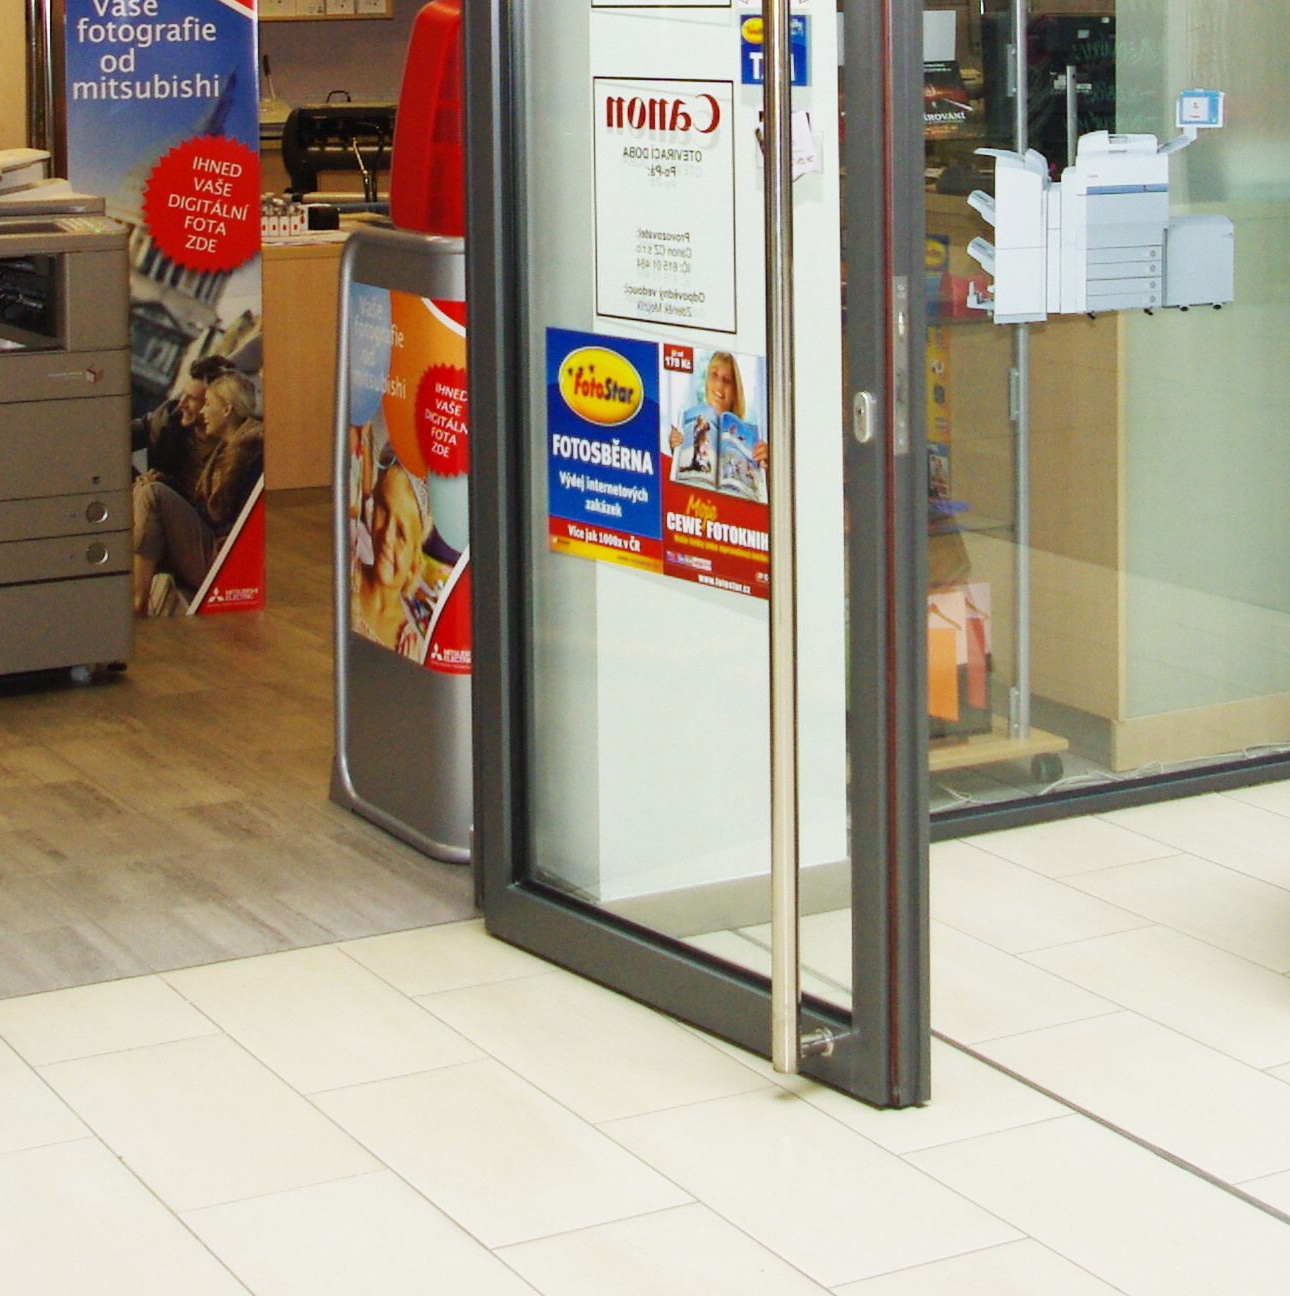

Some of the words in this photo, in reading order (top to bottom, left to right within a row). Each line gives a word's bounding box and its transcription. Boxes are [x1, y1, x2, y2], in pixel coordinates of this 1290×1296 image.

[76, 18, 218, 44] fotografie
[99, 50, 136, 73] od
[72, 73, 220, 101] mitsubishi
[191, 157, 243, 179] IHNED
[193, 175, 233, 197] VAŠE
[167, 193, 248, 221] DIGITÁLNÍ
[184, 216, 227, 236] FOTA
[185, 235, 217, 253] ZDE
[574, 372, 634, 404] FotoStar
[436, 397, 462, 417] VAŠE
[431, 425, 458, 446] FOTA
[432, 440, 451, 459] ZDE
[552, 433, 654, 475] FOTOSBĚRNA
[559, 471, 585, 492] Výdej
[585, 473, 649, 503] internetových
[585, 498, 623, 518] zakázek
[666, 511, 703, 537] CEWE
[707, 520, 769, 552] FOTOKNIH
